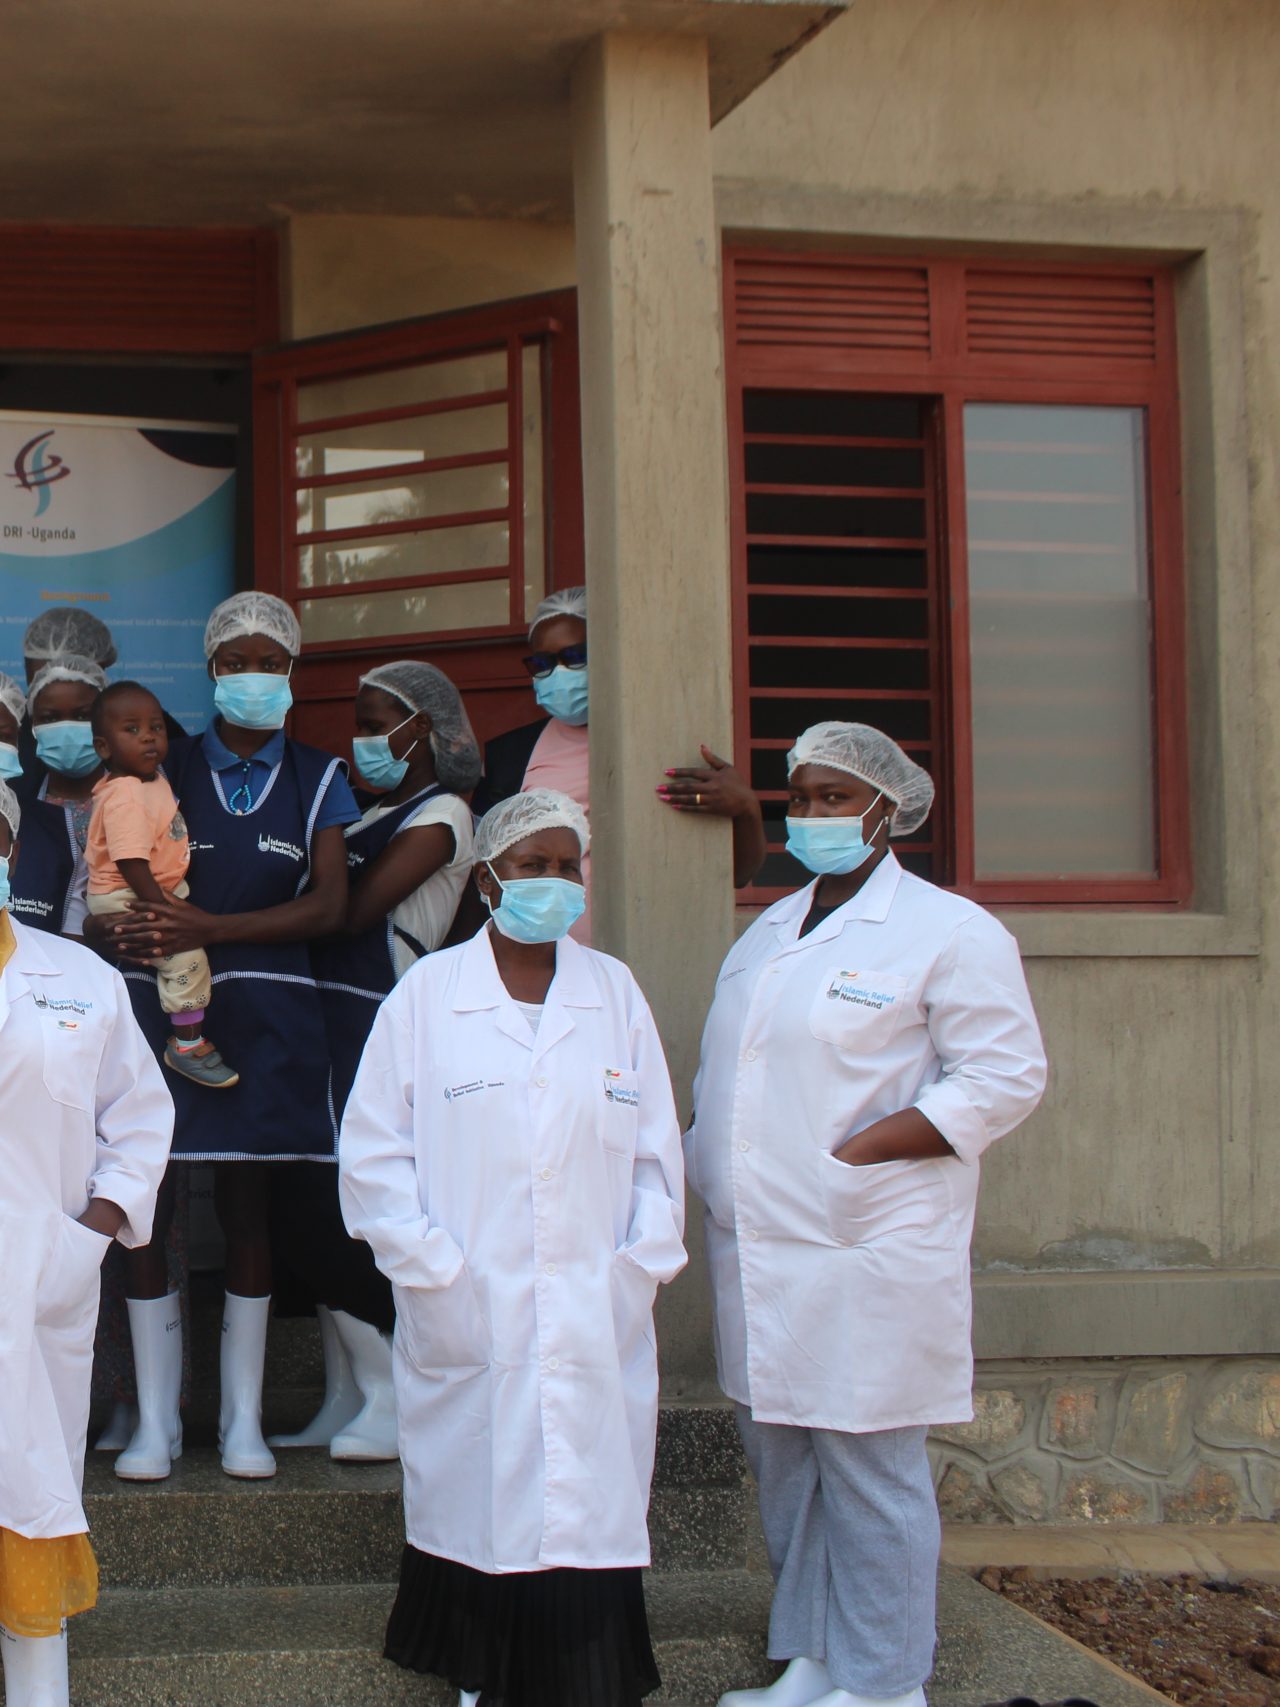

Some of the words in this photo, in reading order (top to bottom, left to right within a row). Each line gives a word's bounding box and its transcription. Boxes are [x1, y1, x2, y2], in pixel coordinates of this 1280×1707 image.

[3, 525, 23, 539] DRI
[839, 992, 883, 1010] Nederland
[841, 984, 870, 998] Islamic
[870, 991, 896, 1004] Relief
[49, 1003, 86, 1016] Nederland
